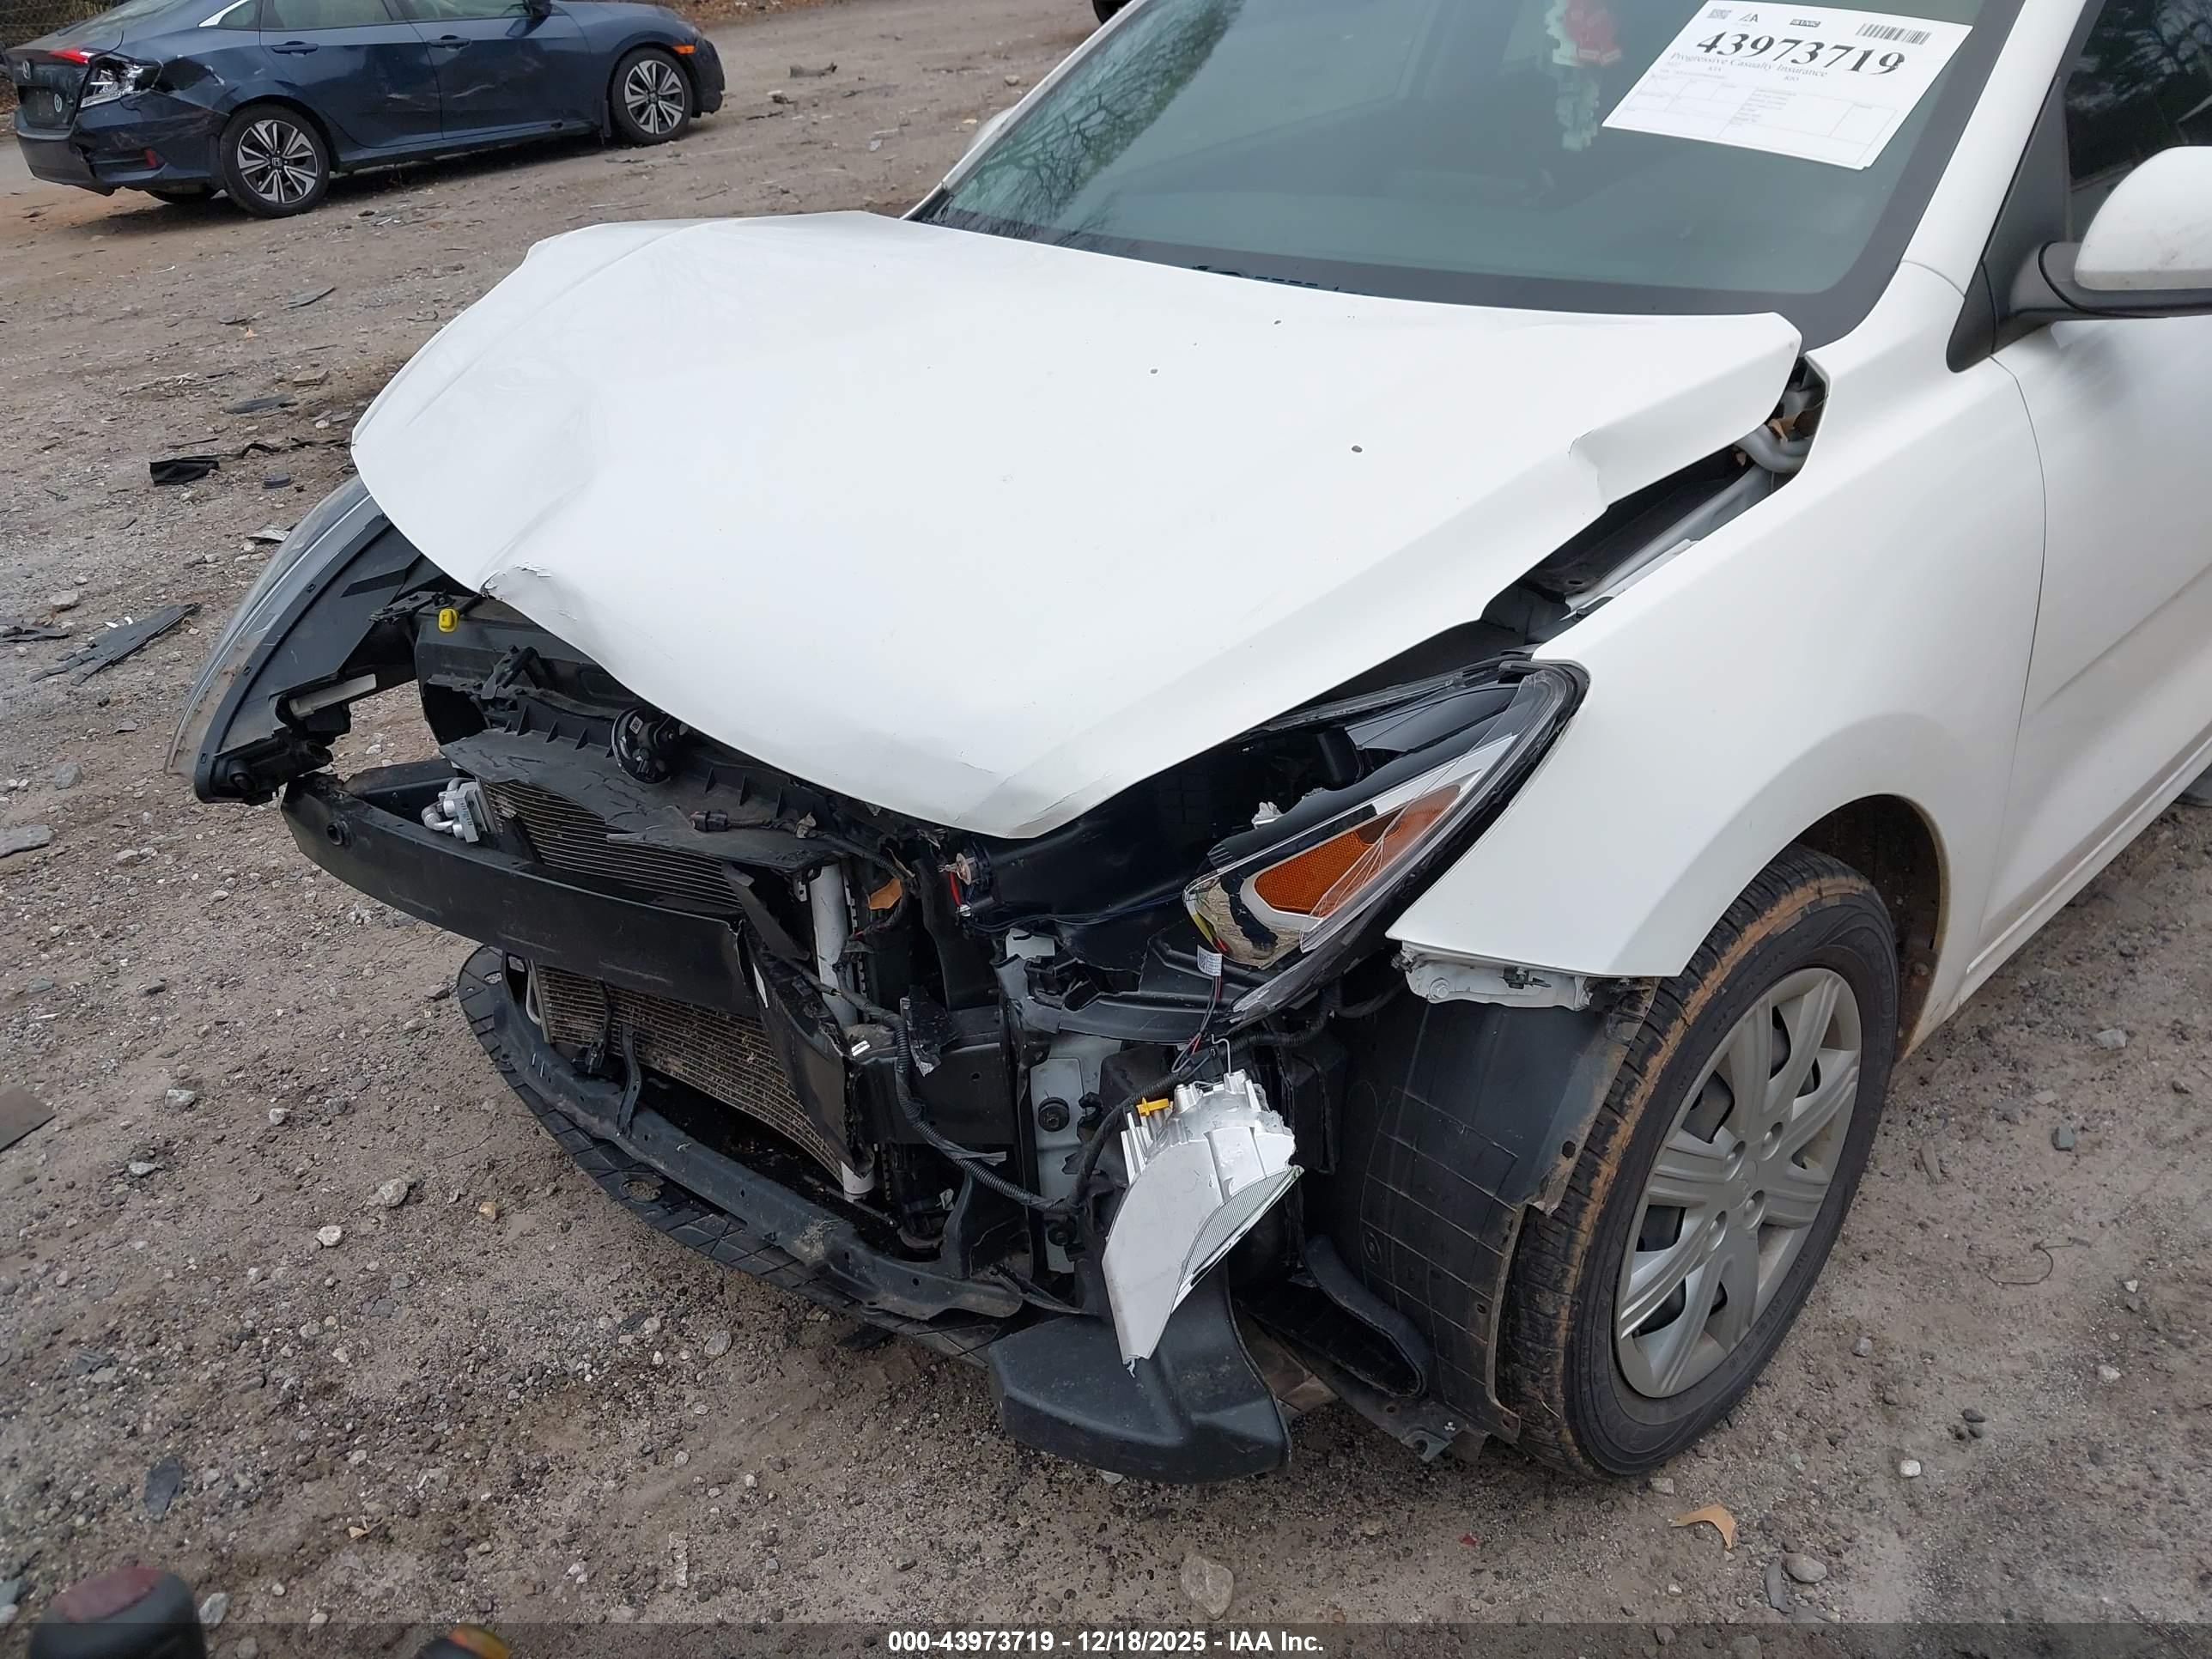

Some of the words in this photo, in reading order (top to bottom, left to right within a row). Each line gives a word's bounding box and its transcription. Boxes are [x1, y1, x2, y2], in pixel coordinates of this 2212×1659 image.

[1670, 52, 1729, 64] Progressive
[1730, 58, 1771, 70] Casualty
[1777, 64, 1828, 77] Insurance
[1697, 31, 1905, 75] 43973719
